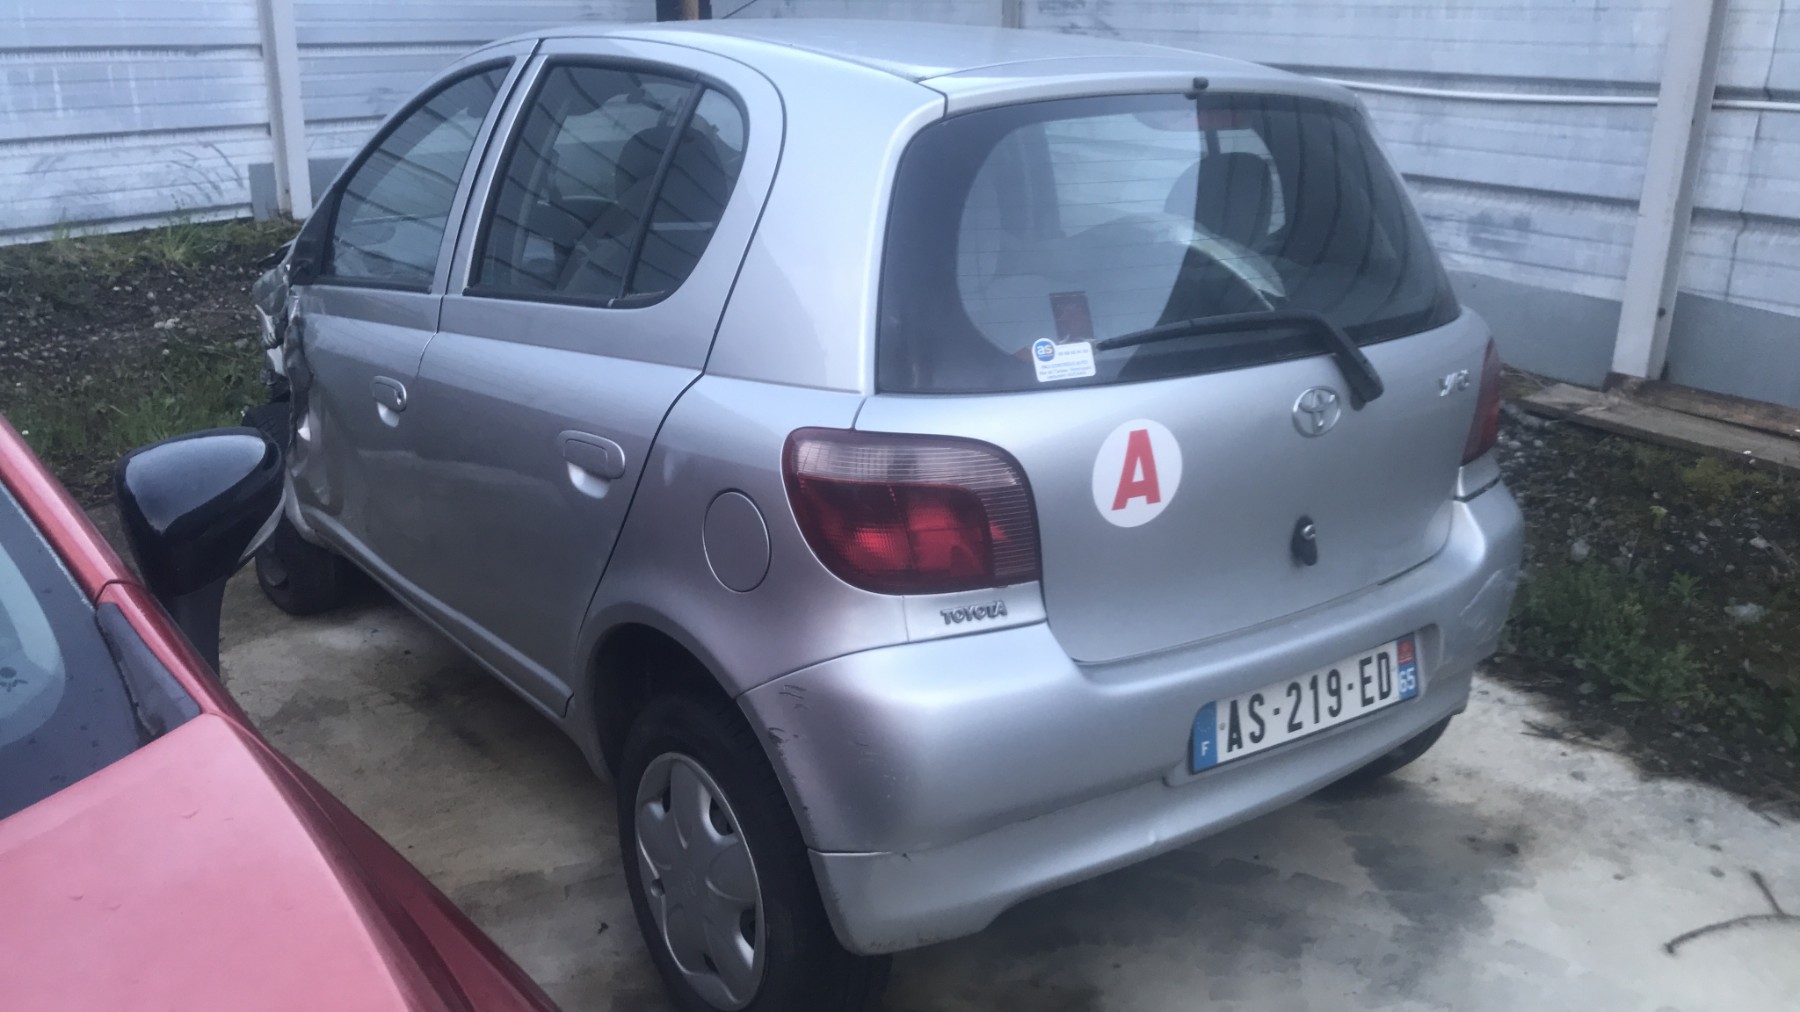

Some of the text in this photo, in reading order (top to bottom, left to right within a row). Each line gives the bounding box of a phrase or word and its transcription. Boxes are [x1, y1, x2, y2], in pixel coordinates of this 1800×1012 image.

[1036, 345, 1053, 355] as
[1111, 429, 1161, 511] A
[940, 600, 1008, 625] TOYOTA
[1400, 667, 1416, 692] 65
[1227, 651, 1392, 753] AS-219-ED
[1201, 741, 1210, 756] F
